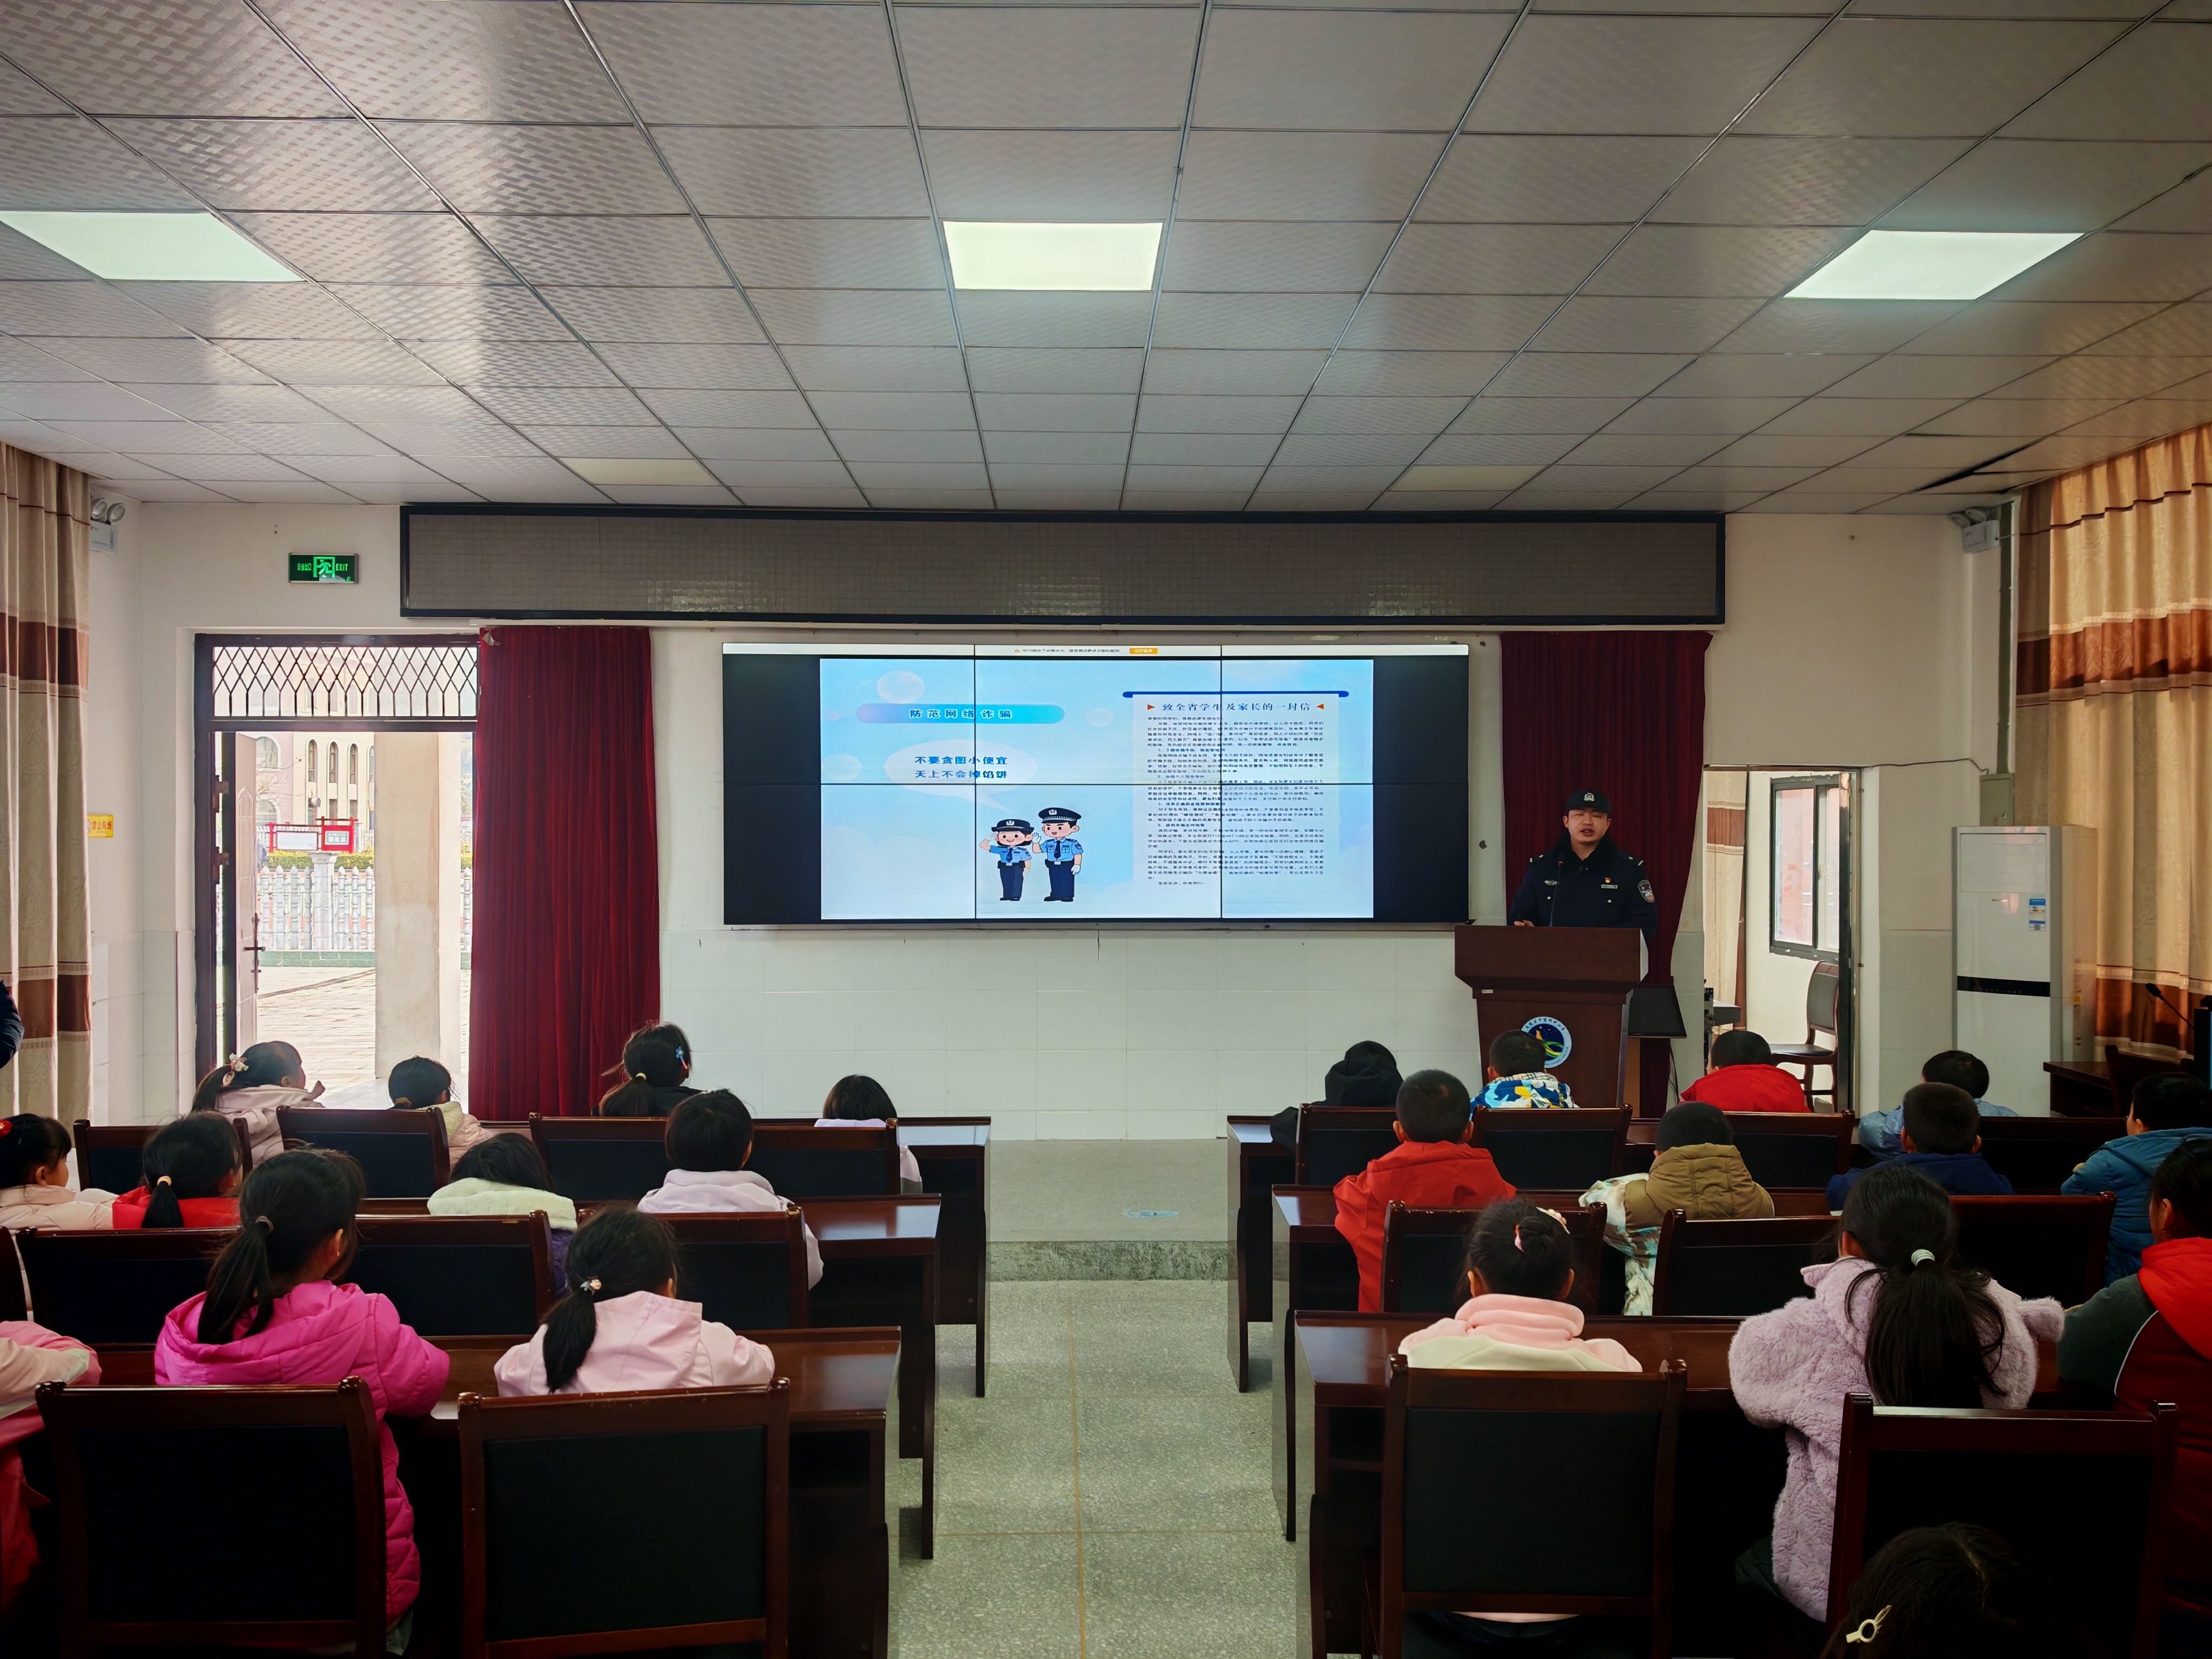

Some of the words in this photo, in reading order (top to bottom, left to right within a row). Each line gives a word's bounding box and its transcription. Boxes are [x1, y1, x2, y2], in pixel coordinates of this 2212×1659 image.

[336, 563, 348, 571] EXIT
[909, 709, 1012, 719] 防范网络诈骗
[914, 756, 1007, 764] 不要贪图小便宜
[914, 770, 1007, 779] 天上不会掉馅饼
